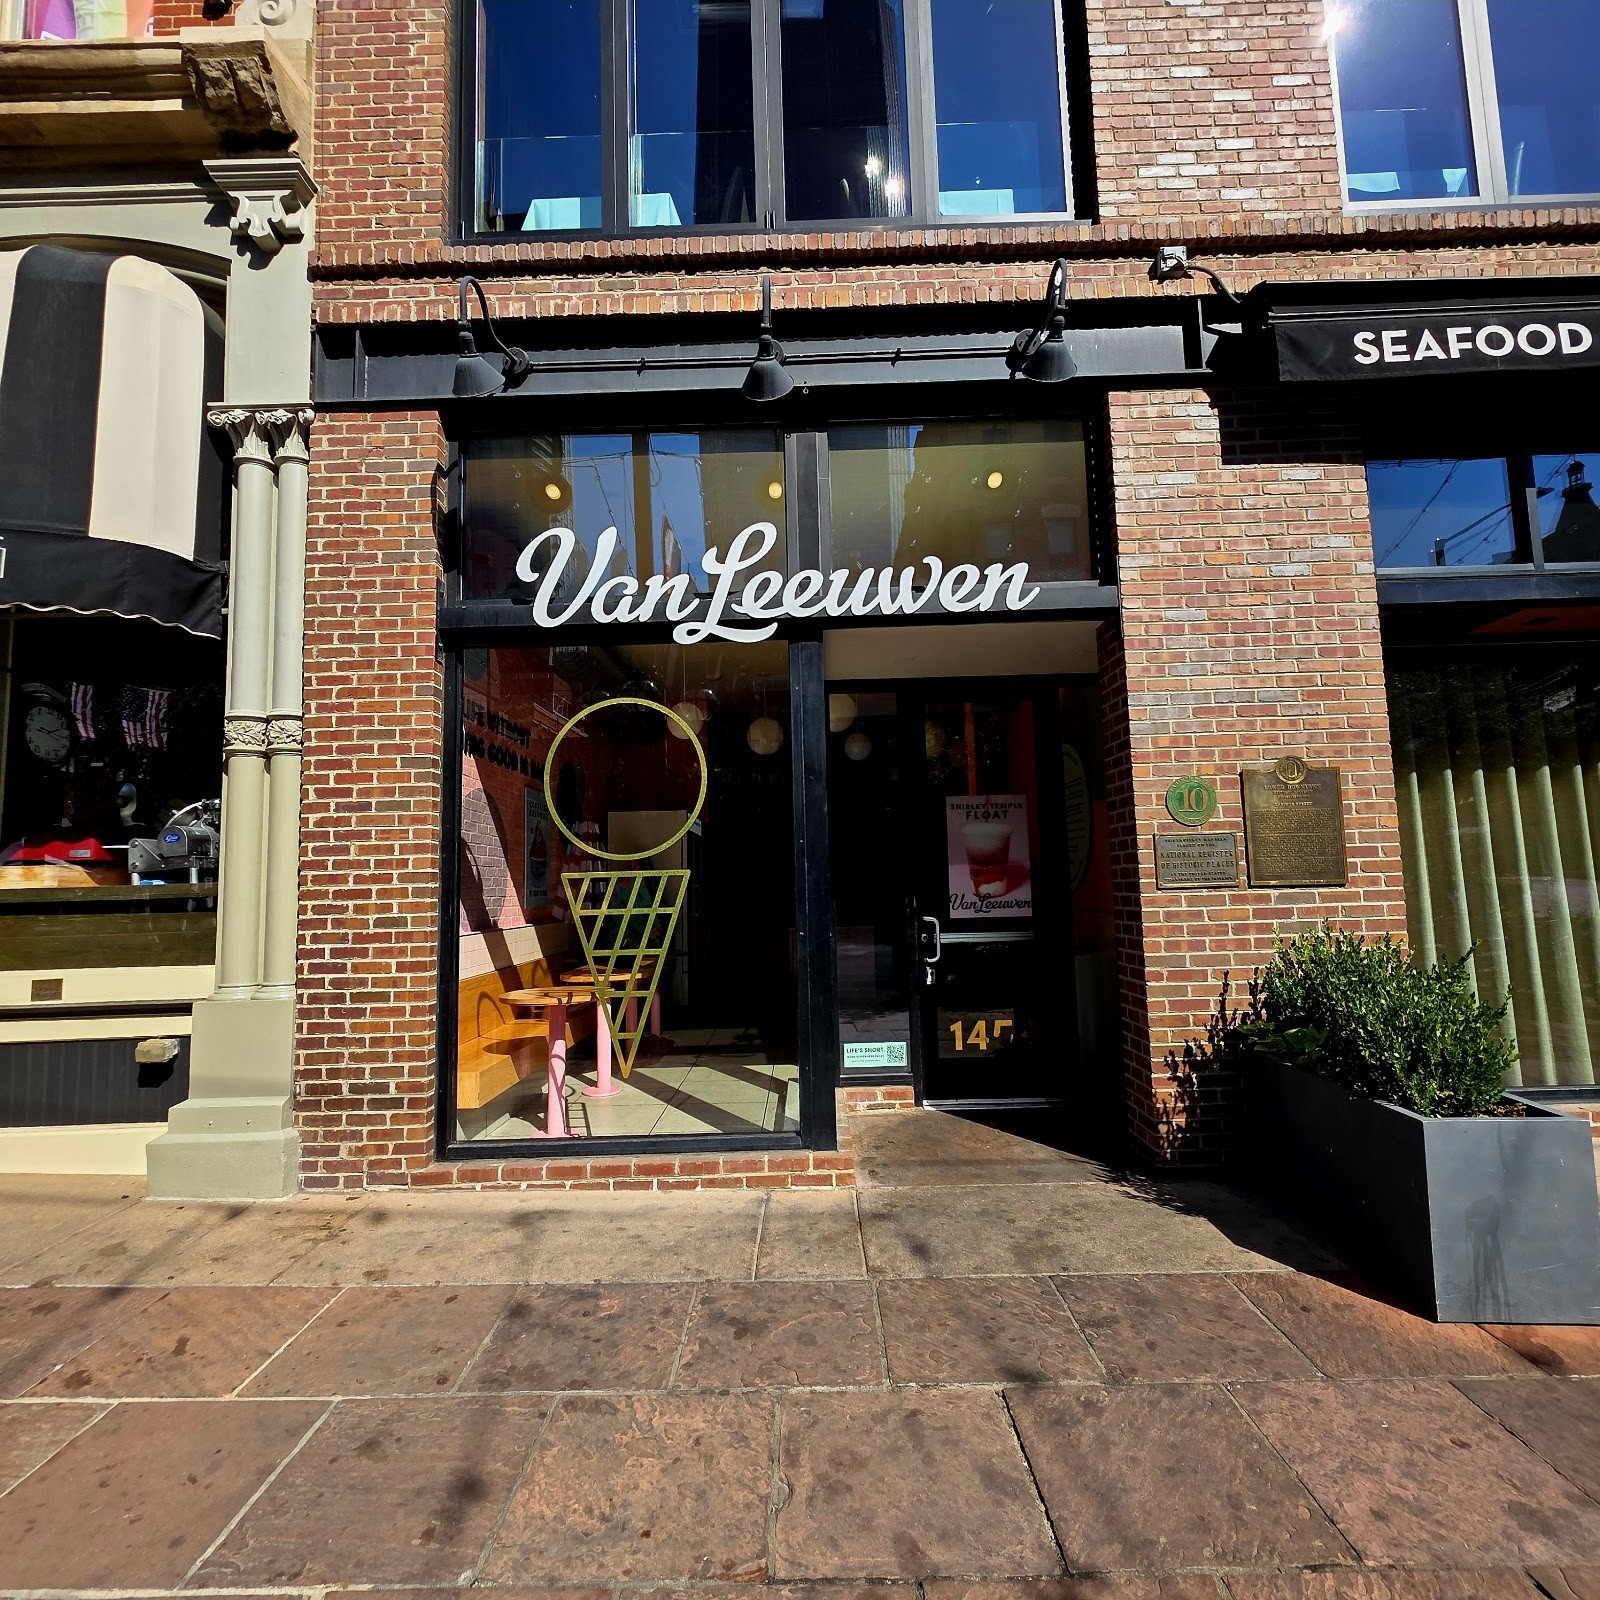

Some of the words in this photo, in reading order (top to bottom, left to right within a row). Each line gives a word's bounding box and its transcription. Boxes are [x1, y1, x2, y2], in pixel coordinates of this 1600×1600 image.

[1353, 322, 1593, 364] SEAFOOD
[1176, 787, 1209, 812] 10
[950, 802, 987, 811] SHIRLEY
[989, 802, 1024, 810] TEMPLE
[965, 810, 1009, 820] FLOAT
[1160, 850, 1196, 859] NATIONAL
[1198, 849, 1233, 858] REGISTER
[1161, 862, 1171, 870] OF
[1172, 861, 1204, 869] HISTORIC
[1206, 860, 1234, 868] PLACES
